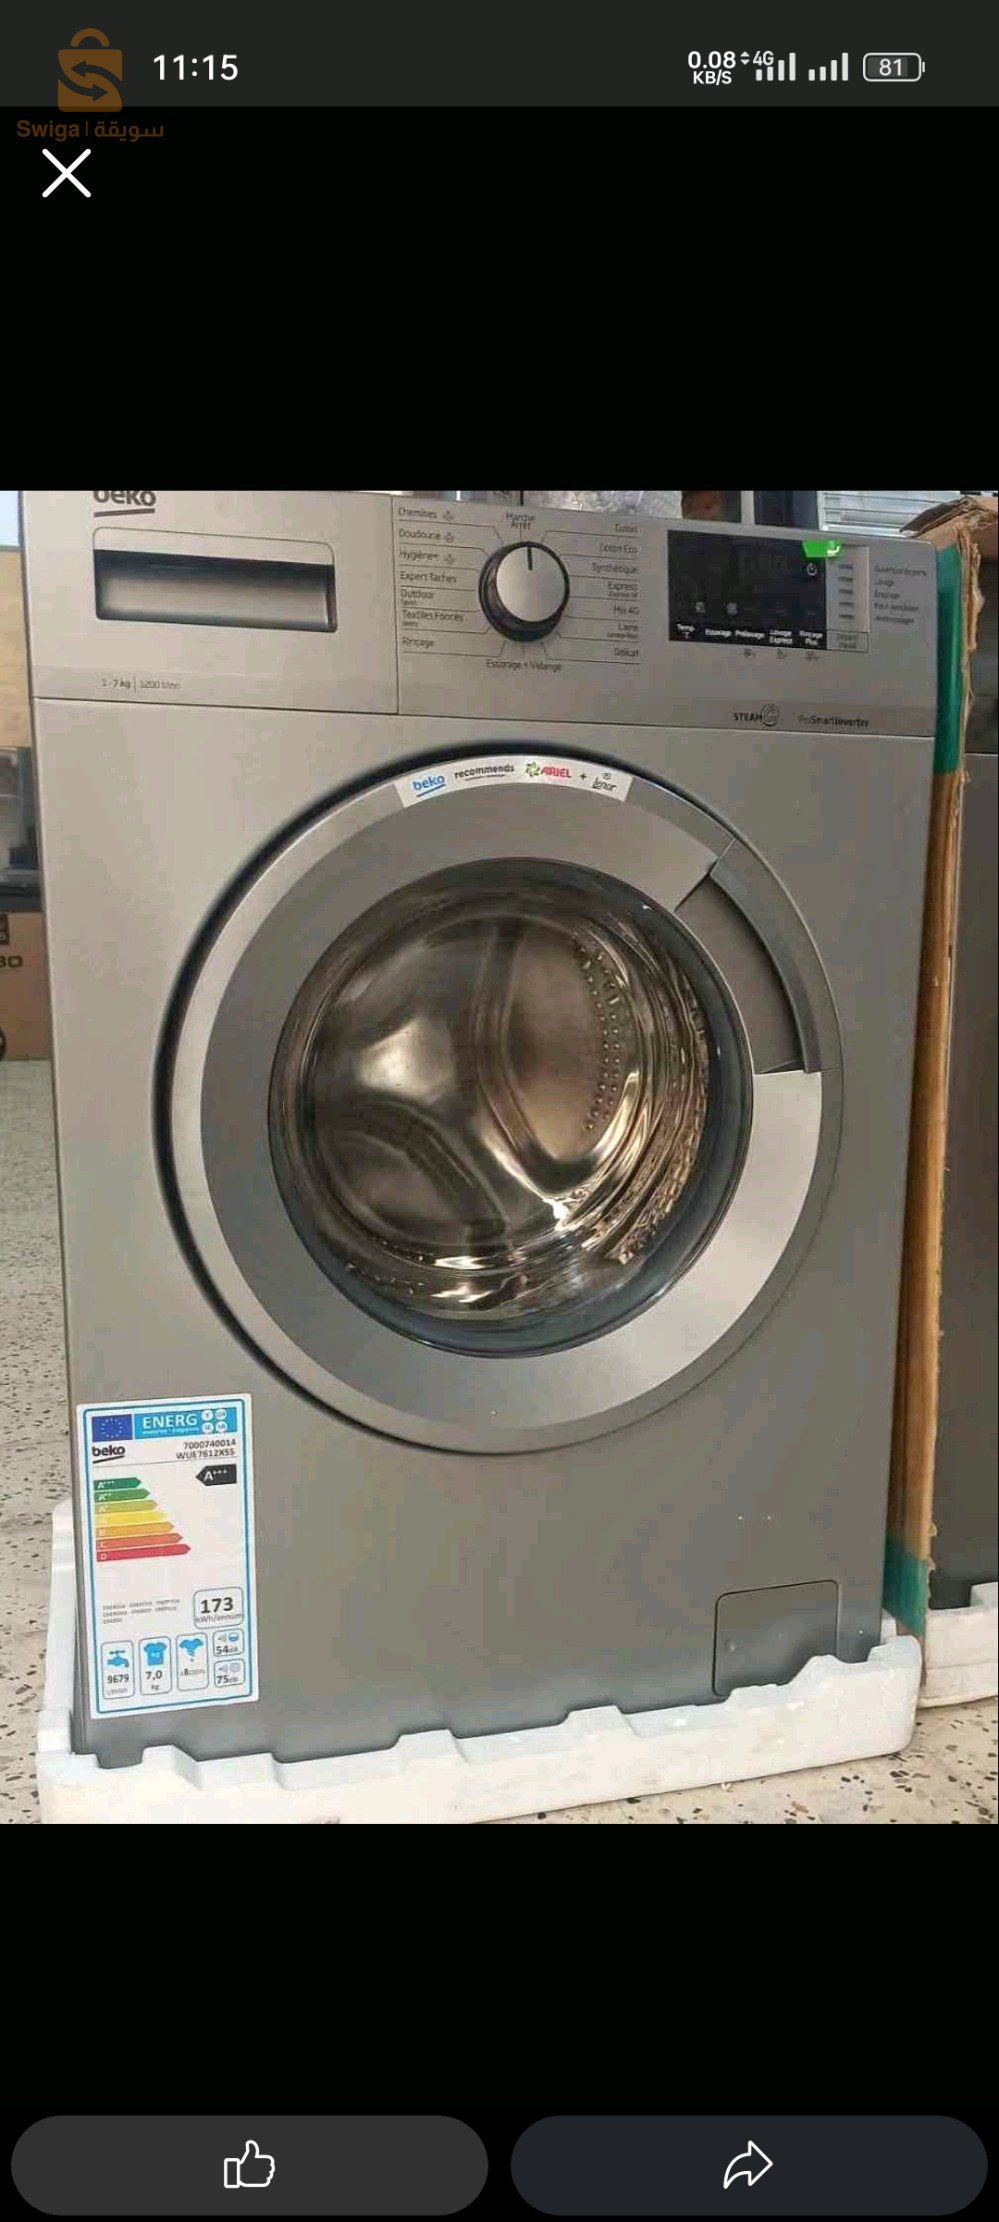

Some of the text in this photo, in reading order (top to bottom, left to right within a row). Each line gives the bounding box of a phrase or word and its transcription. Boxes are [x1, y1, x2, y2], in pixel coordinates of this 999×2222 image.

[399, 507, 437, 518] Chemises
[401, 589, 434, 599] Outdoor
[530, 661, 561, 672] Vidange
[120, 680, 131, 691] kg
[733, 712, 763, 722] STEAM
[412, 763, 515, 792] beko recommends
[540, 766, 572, 779] ARIEL
[142, 1413, 198, 1430] ENERG
[92, 1445, 126, 1457] beko
[204, 1468, 228, 1481] A+++
[200, 1597, 234, 1614] 173
[195, 1612, 244, 1624] kWh/annum
[107, 1673, 130, 1684] 9679
[145, 1669, 163, 1681] 7,0
